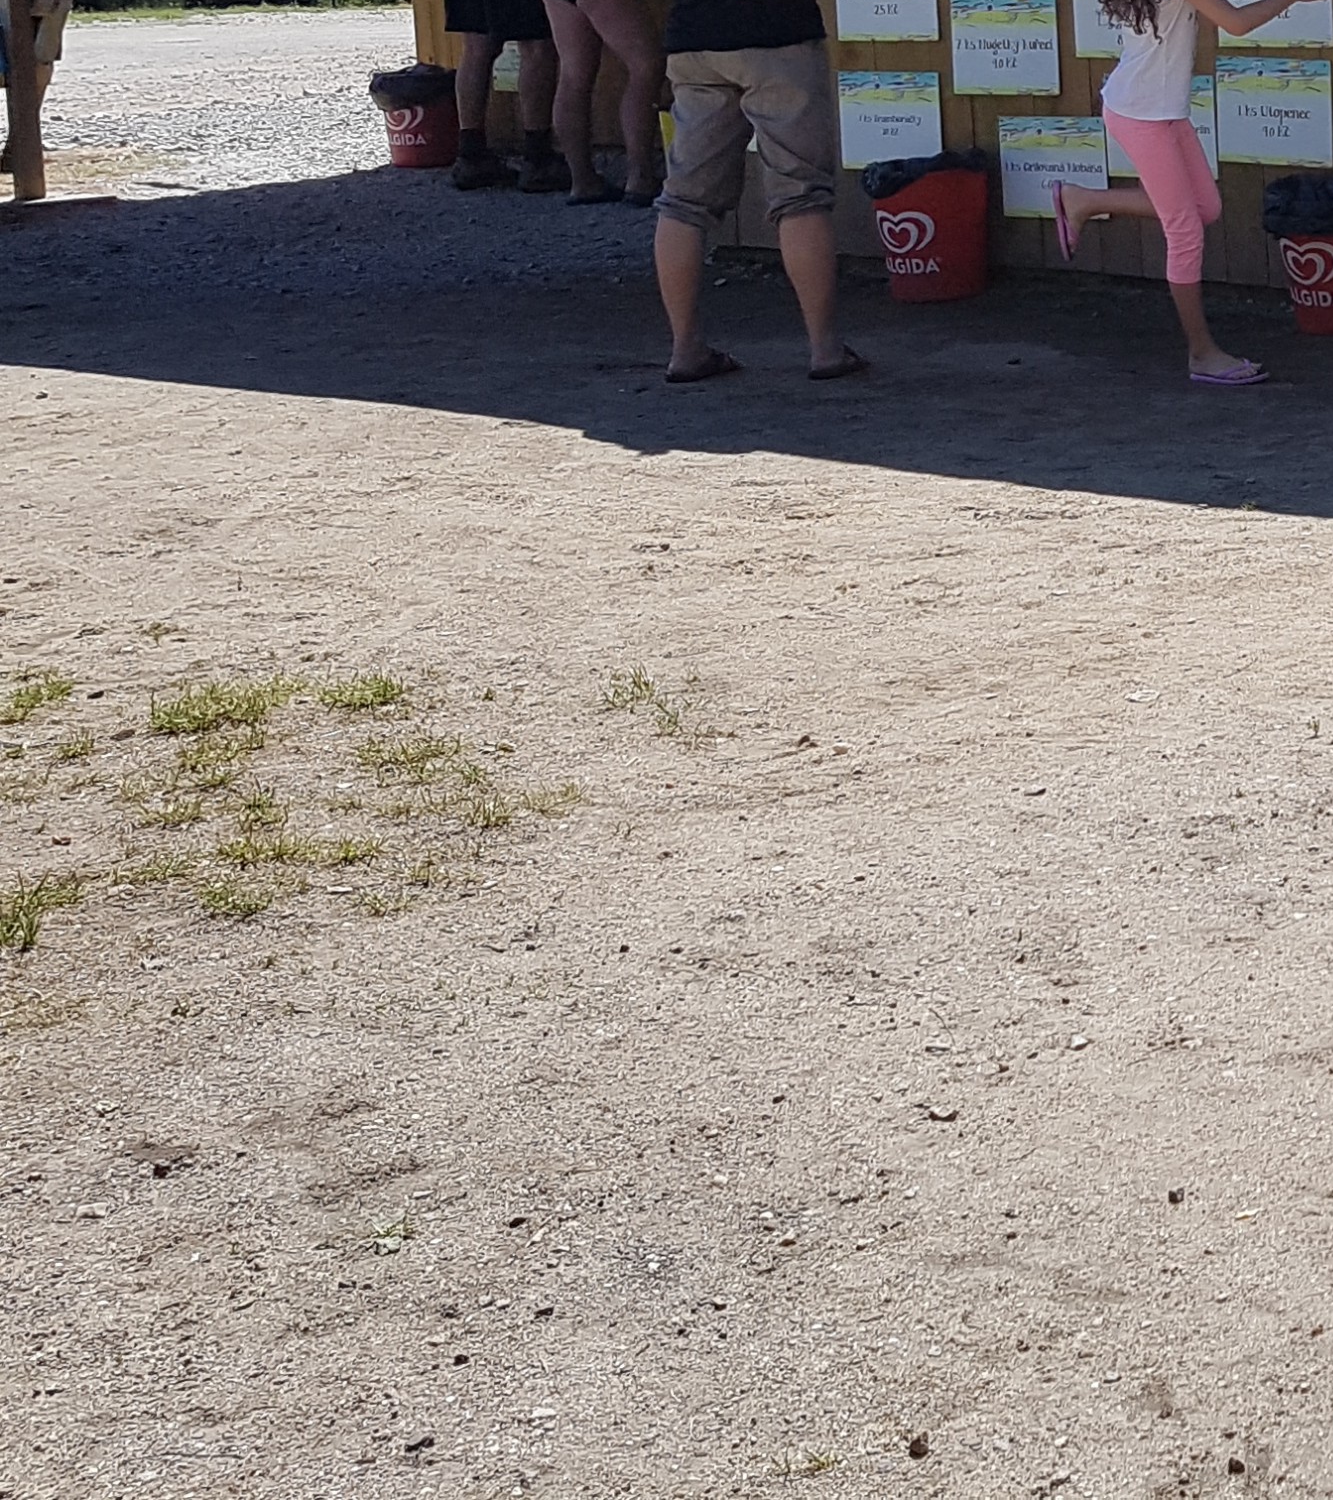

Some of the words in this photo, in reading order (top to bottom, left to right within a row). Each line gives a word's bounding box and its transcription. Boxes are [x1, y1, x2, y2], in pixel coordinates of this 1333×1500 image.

[873, 4, 886, 16] 25
[887, 2, 899, 16] Kč
[1244, 104, 1258, 117] ks
[1260, 105, 1311, 126] Utopenec
[1277, 125, 1291, 137] Kč
[388, 133, 428, 147] LGIDA
